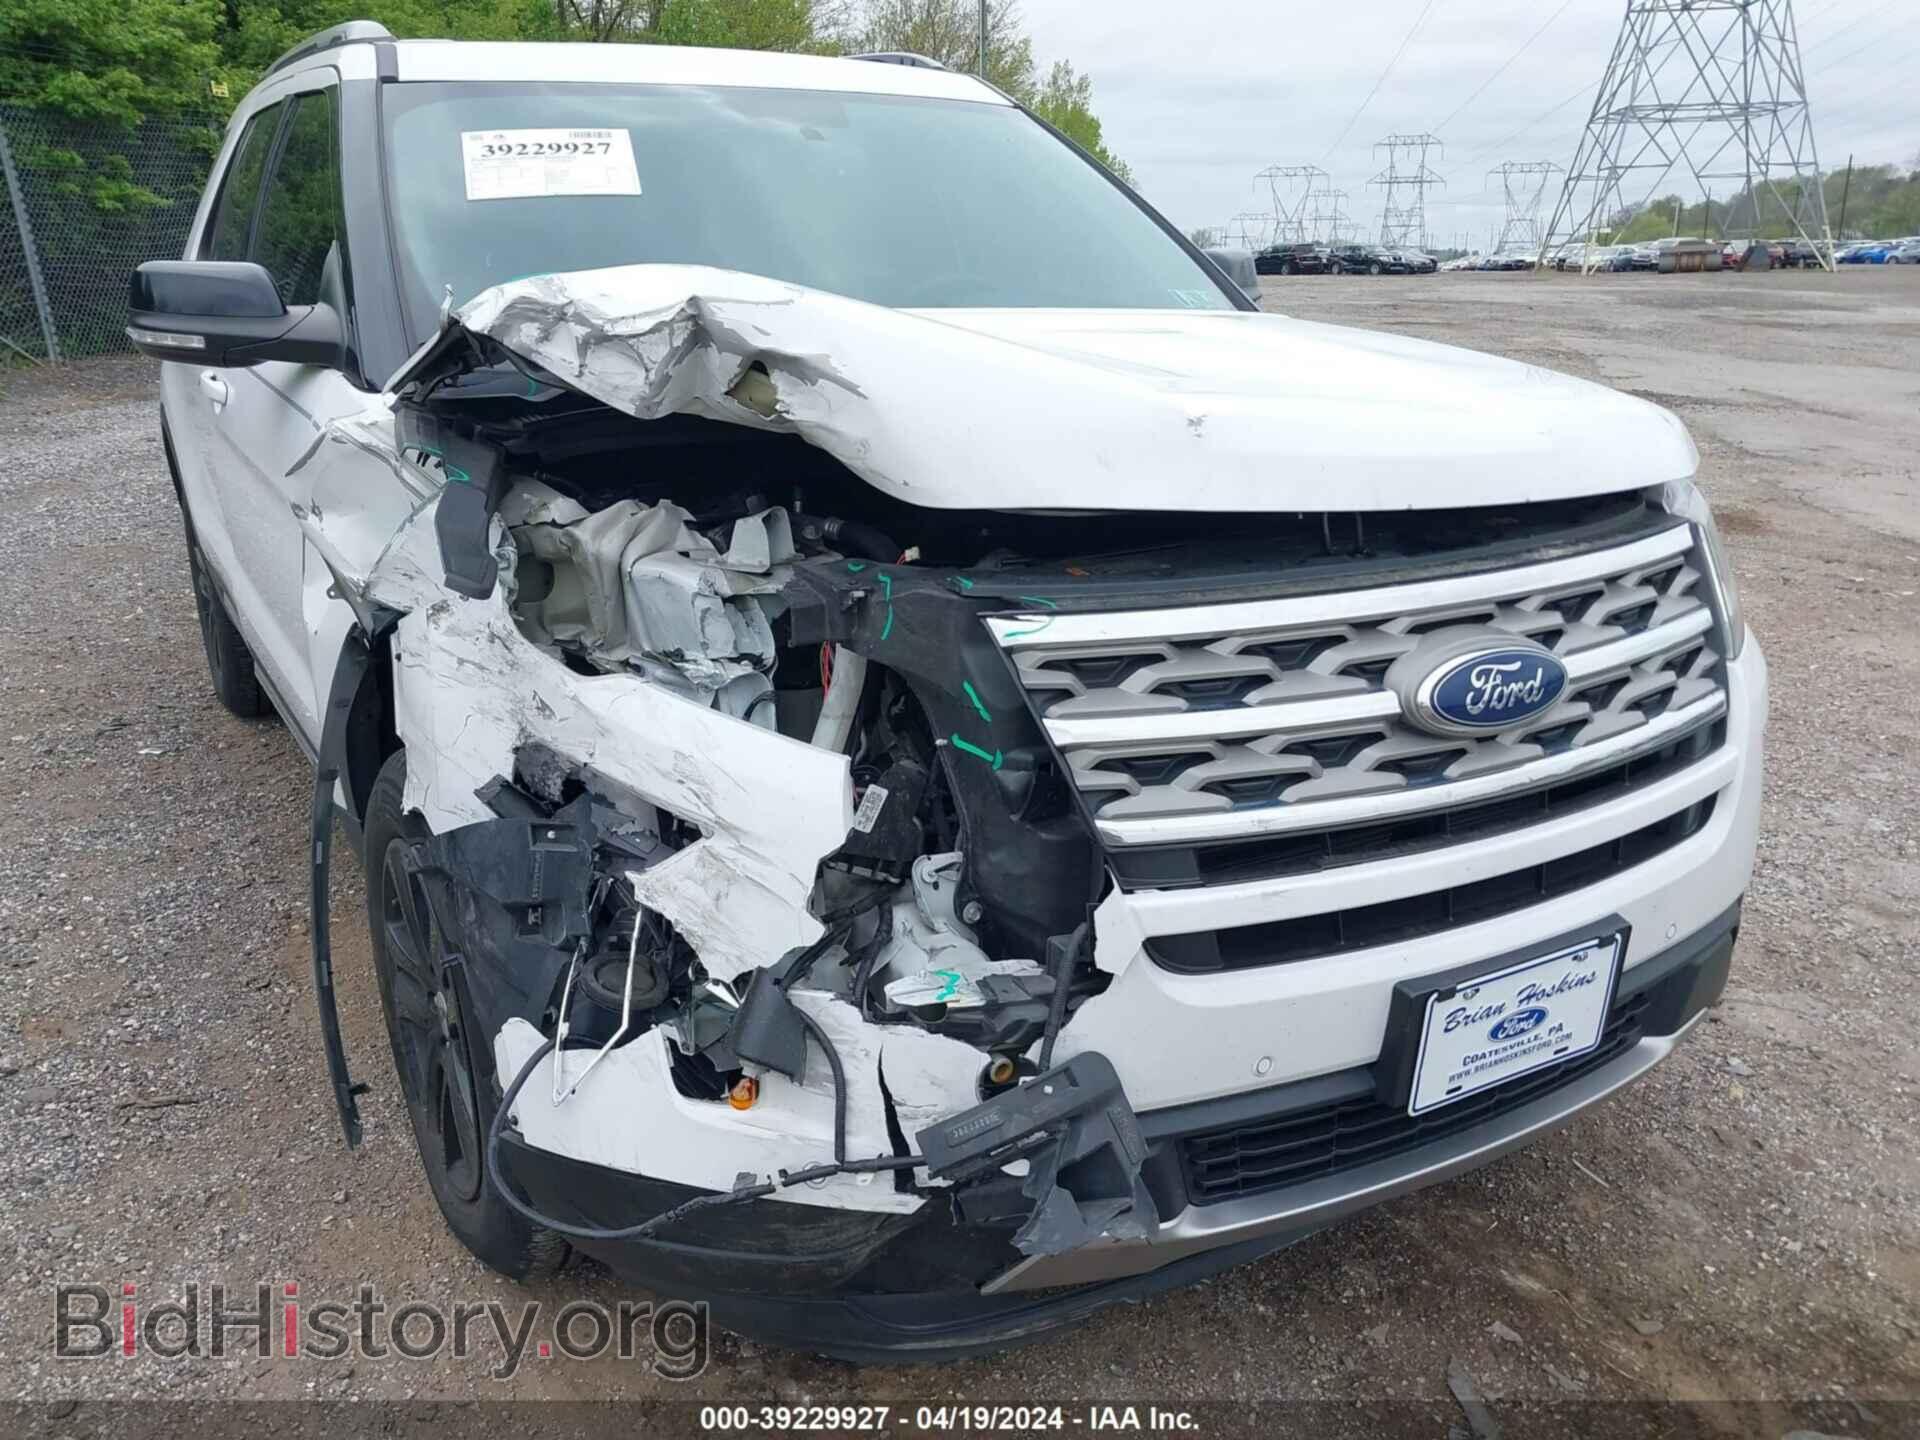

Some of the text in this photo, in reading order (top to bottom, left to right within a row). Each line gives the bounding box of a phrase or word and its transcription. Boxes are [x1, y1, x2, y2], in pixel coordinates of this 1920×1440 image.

[481, 142, 612, 157] 39229927
[1465, 660, 1543, 715] Ford
[1443, 970, 1597, 1033] Brian Hoskins
[1498, 1011, 1539, 1038] Ford
[1548, 1022, 1564, 1038] PA
